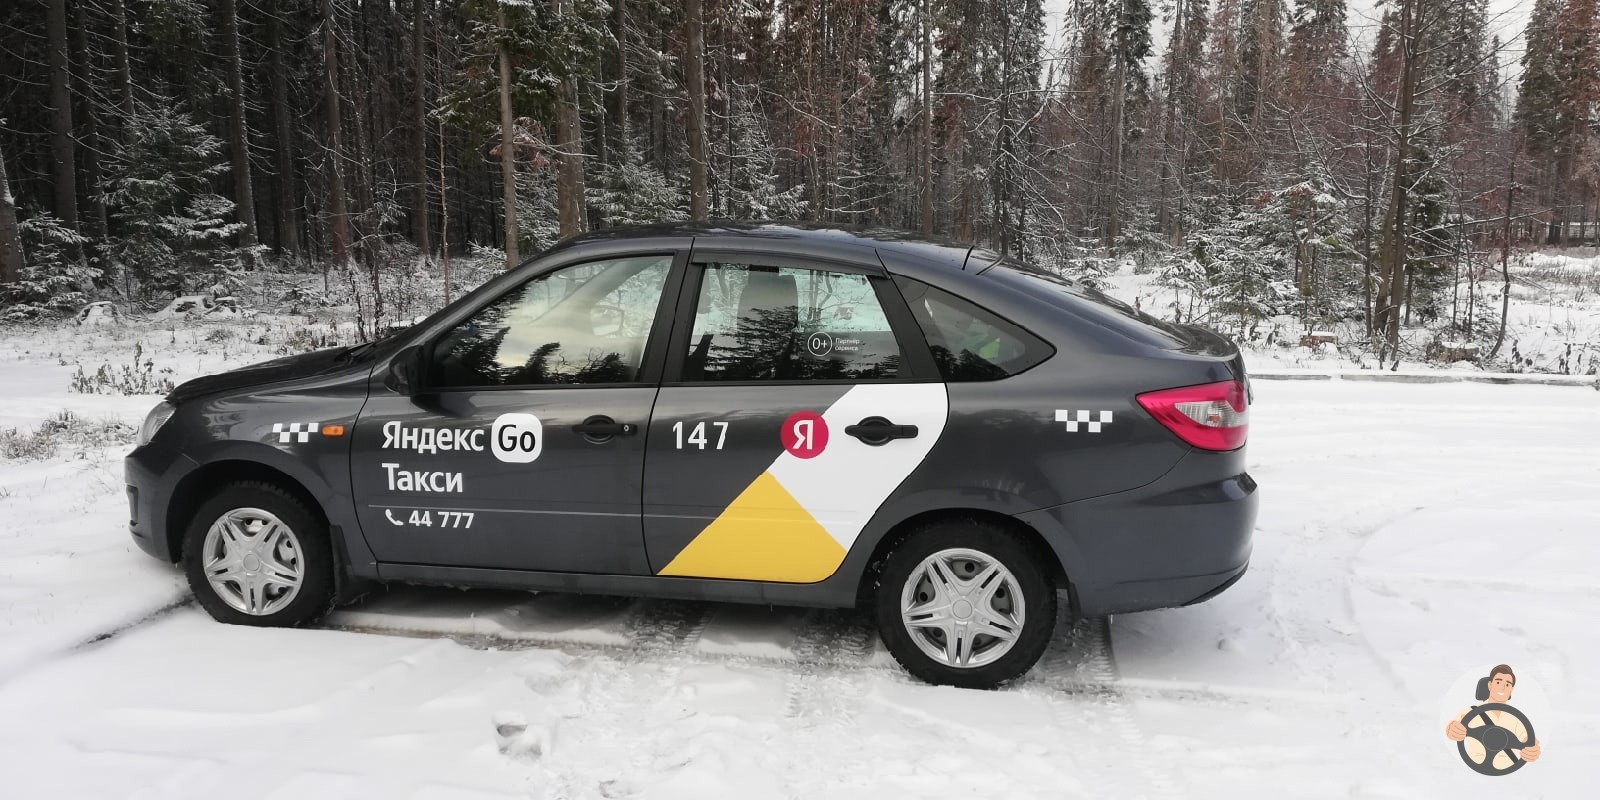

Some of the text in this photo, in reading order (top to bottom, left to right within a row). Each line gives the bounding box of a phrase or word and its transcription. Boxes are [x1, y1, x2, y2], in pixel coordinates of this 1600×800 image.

[812, 337, 828, 350] 0+
[381, 420, 536, 454] Яндекс Go
[672, 421, 729, 450] 147
[792, 419, 814, 450] Я
[381, 463, 463, 493] Такси
[408, 510, 475, 529] 44 777
